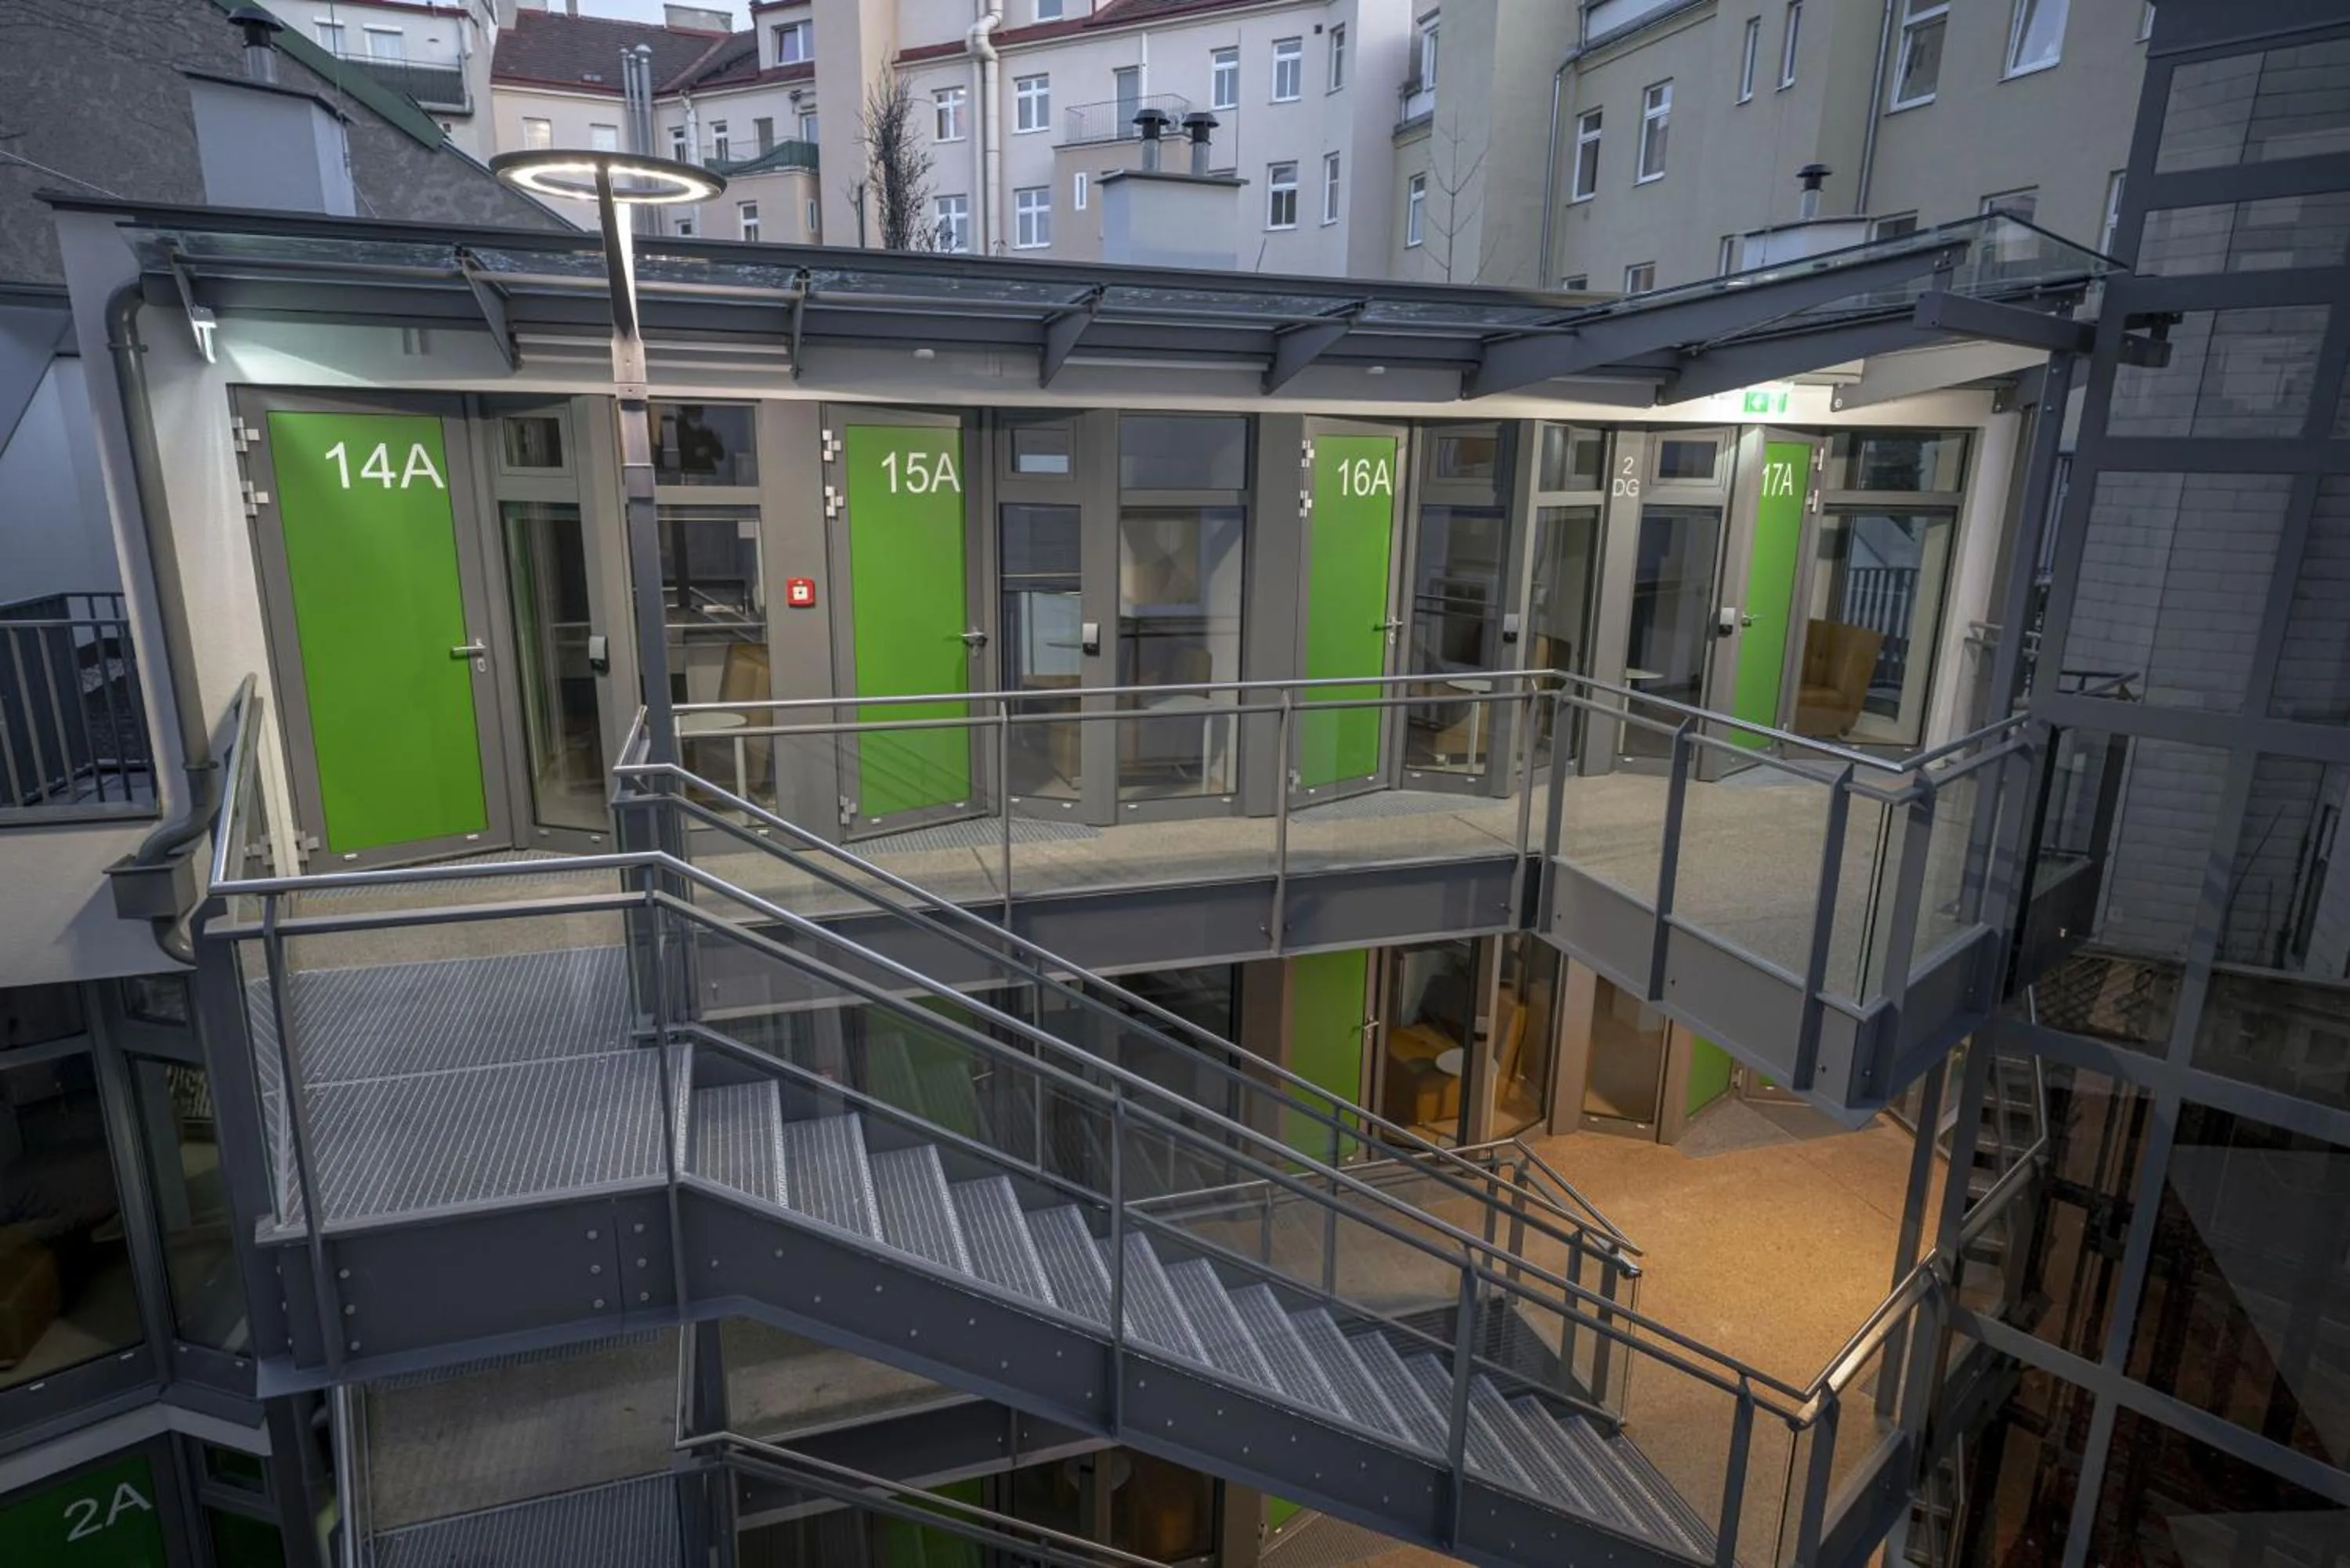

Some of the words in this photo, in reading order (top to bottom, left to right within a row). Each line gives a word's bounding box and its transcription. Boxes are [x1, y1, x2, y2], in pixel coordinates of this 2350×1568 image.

[325, 441, 445, 490] 14A
[880, 451, 961, 494] 15A
[1337, 458, 1392, 496] 16A
[1622, 456, 1634, 475] 2
[1762, 463, 1793, 497] 17A
[1612, 479, 1640, 497] DG
[63, 1481, 153, 1541] 2A
